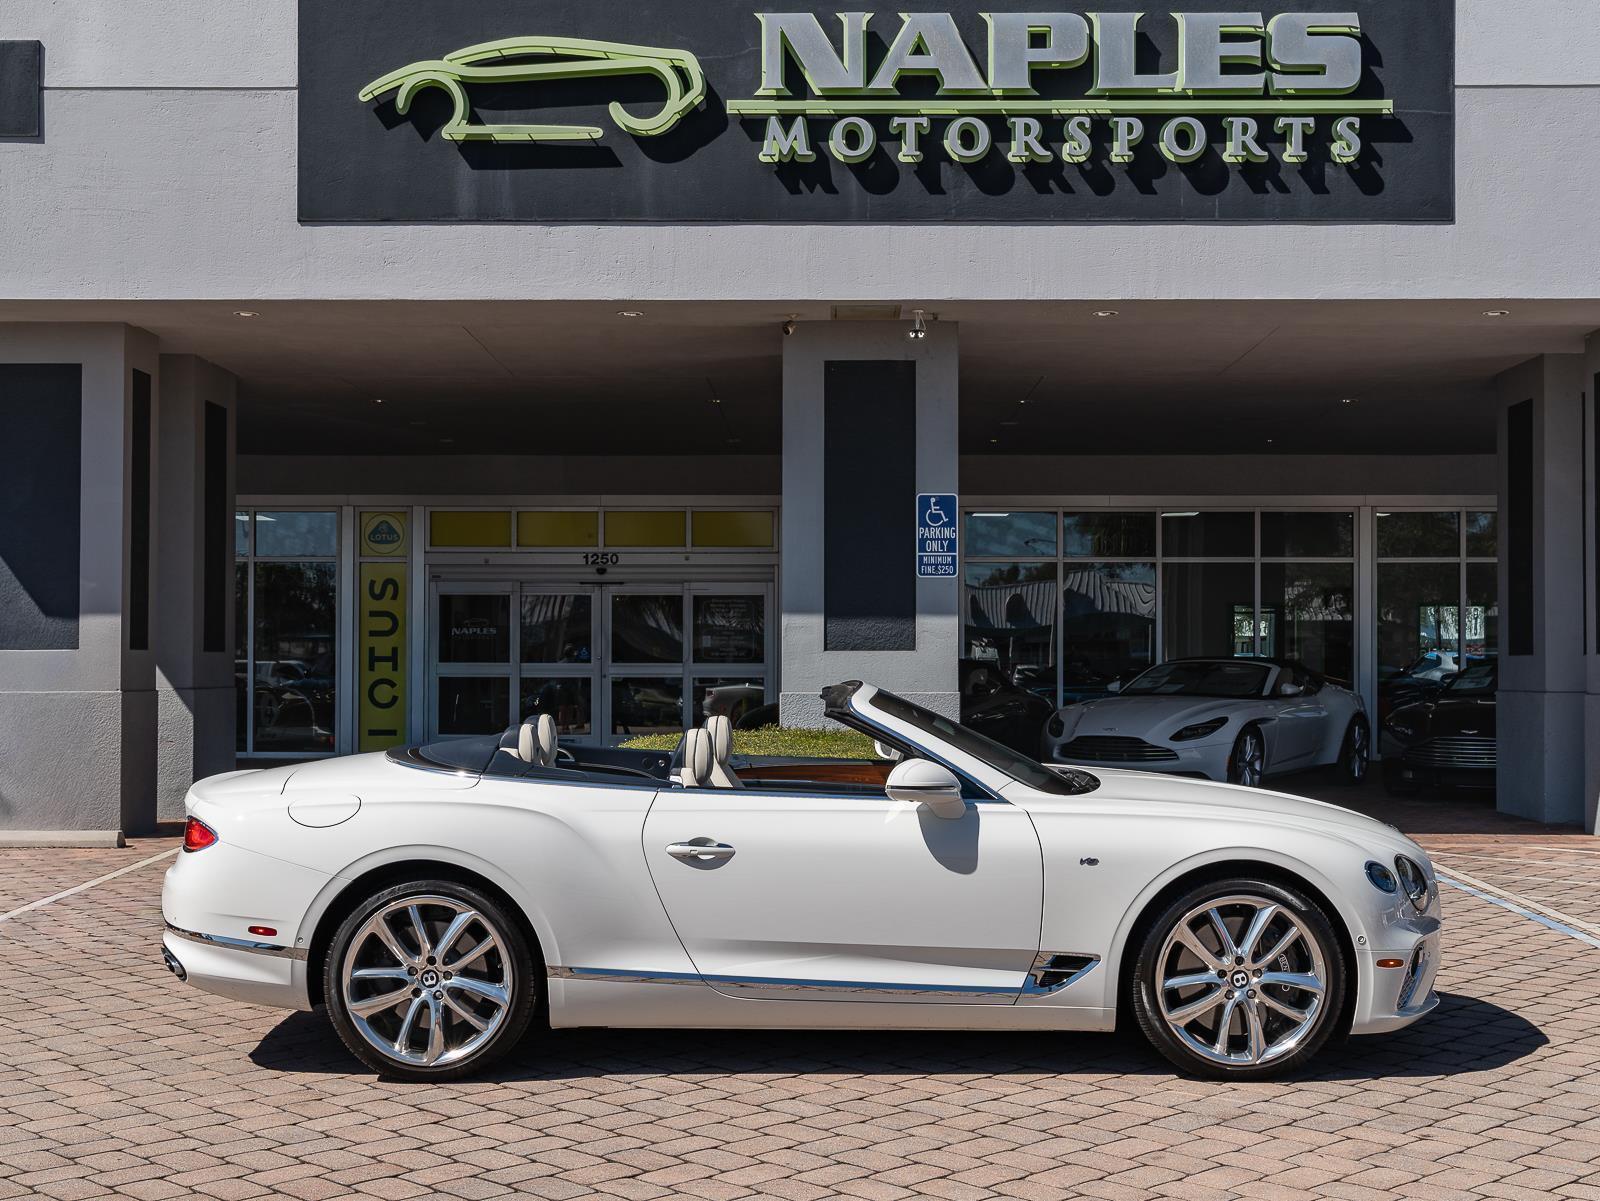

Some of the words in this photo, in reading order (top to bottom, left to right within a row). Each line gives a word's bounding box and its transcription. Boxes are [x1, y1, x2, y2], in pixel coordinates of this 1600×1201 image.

[755, 11, 1363, 96] NAPLES
[759, 115, 1363, 164] MOTORSPORTS
[370, 532, 399, 543] LOTUS
[919, 527, 955, 538] PARKING
[926, 541, 948, 551] ONLY
[583, 553, 619, 565] 1250
[923, 556, 952, 564] MINIMUM
[921, 565, 936, 574] FINE
[937, 565, 954, 575] $250
[451, 627, 497, 636] NAPLES
